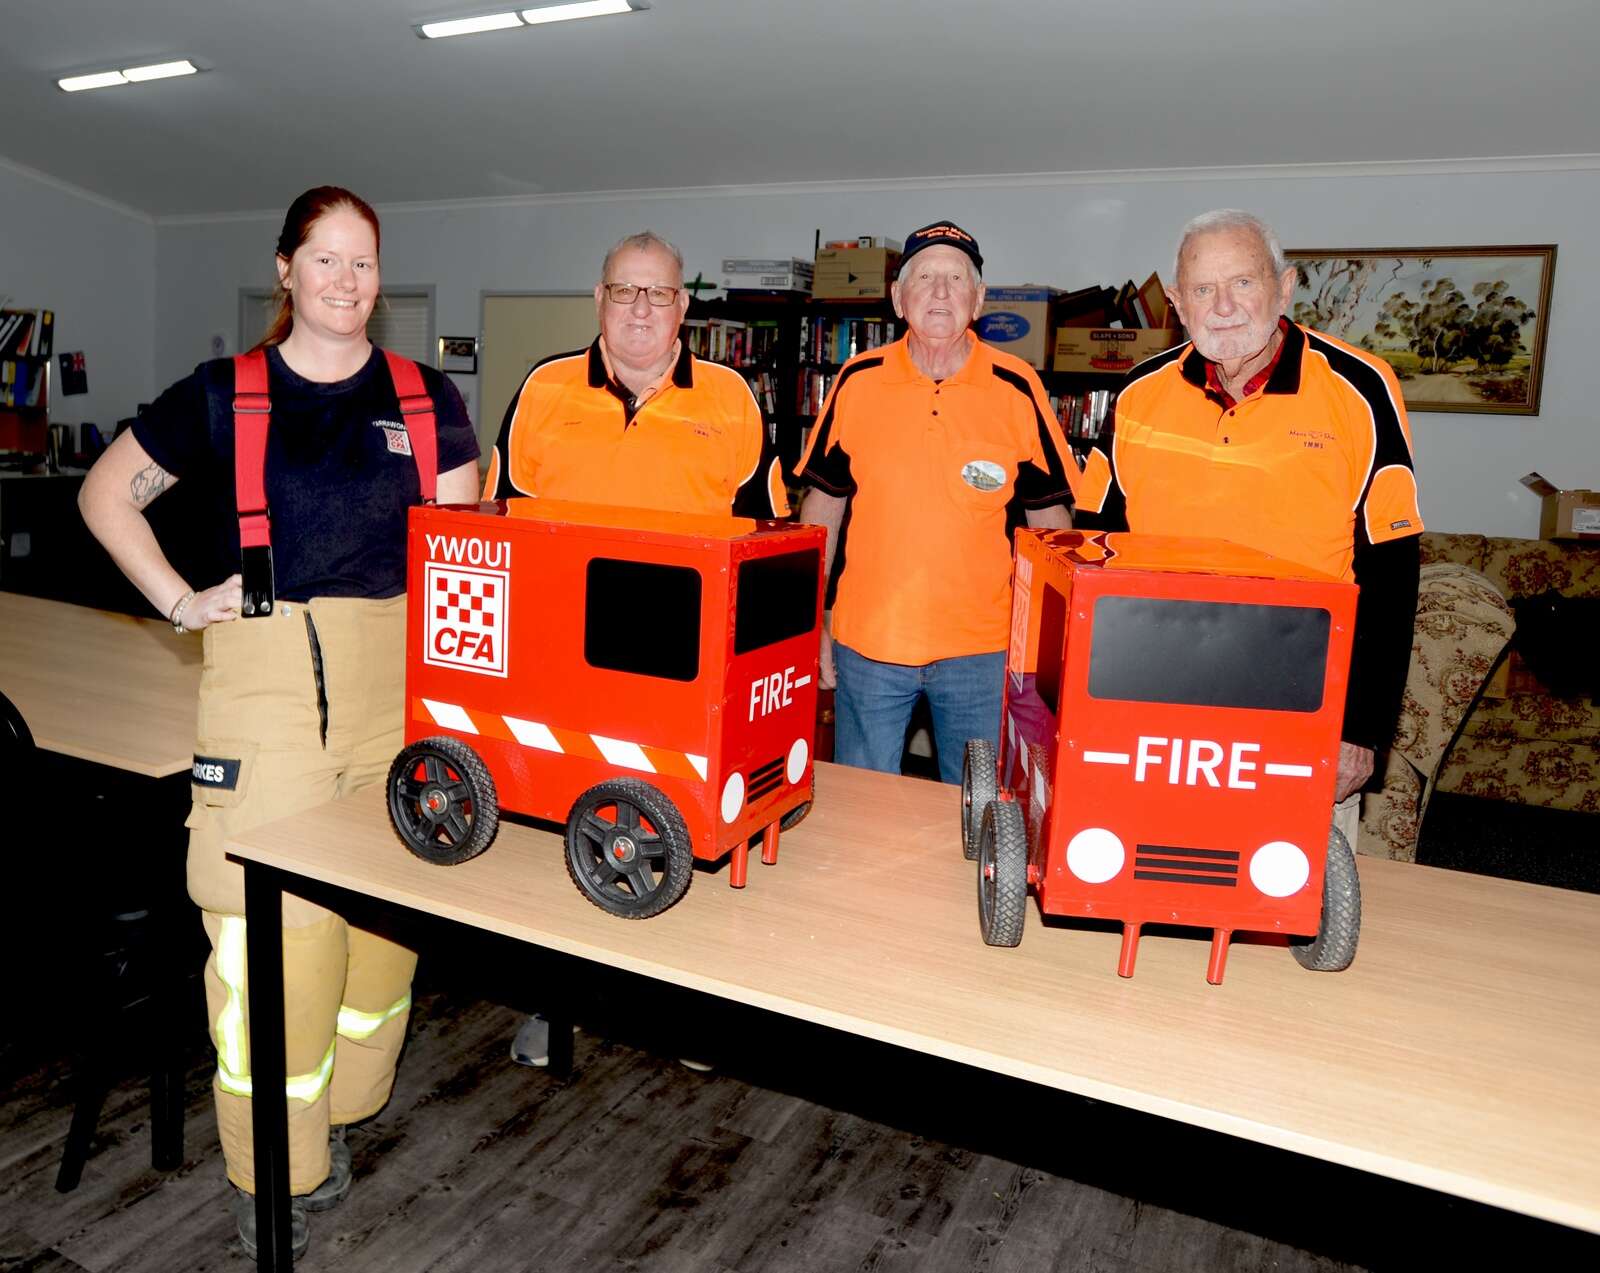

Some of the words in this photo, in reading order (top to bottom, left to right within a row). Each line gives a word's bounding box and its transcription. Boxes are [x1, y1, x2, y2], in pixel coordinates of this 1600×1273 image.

[434, 627, 495, 663] CFA
[748, 665, 796, 722] FIRE
[1134, 735, 1261, 790] FIRE
